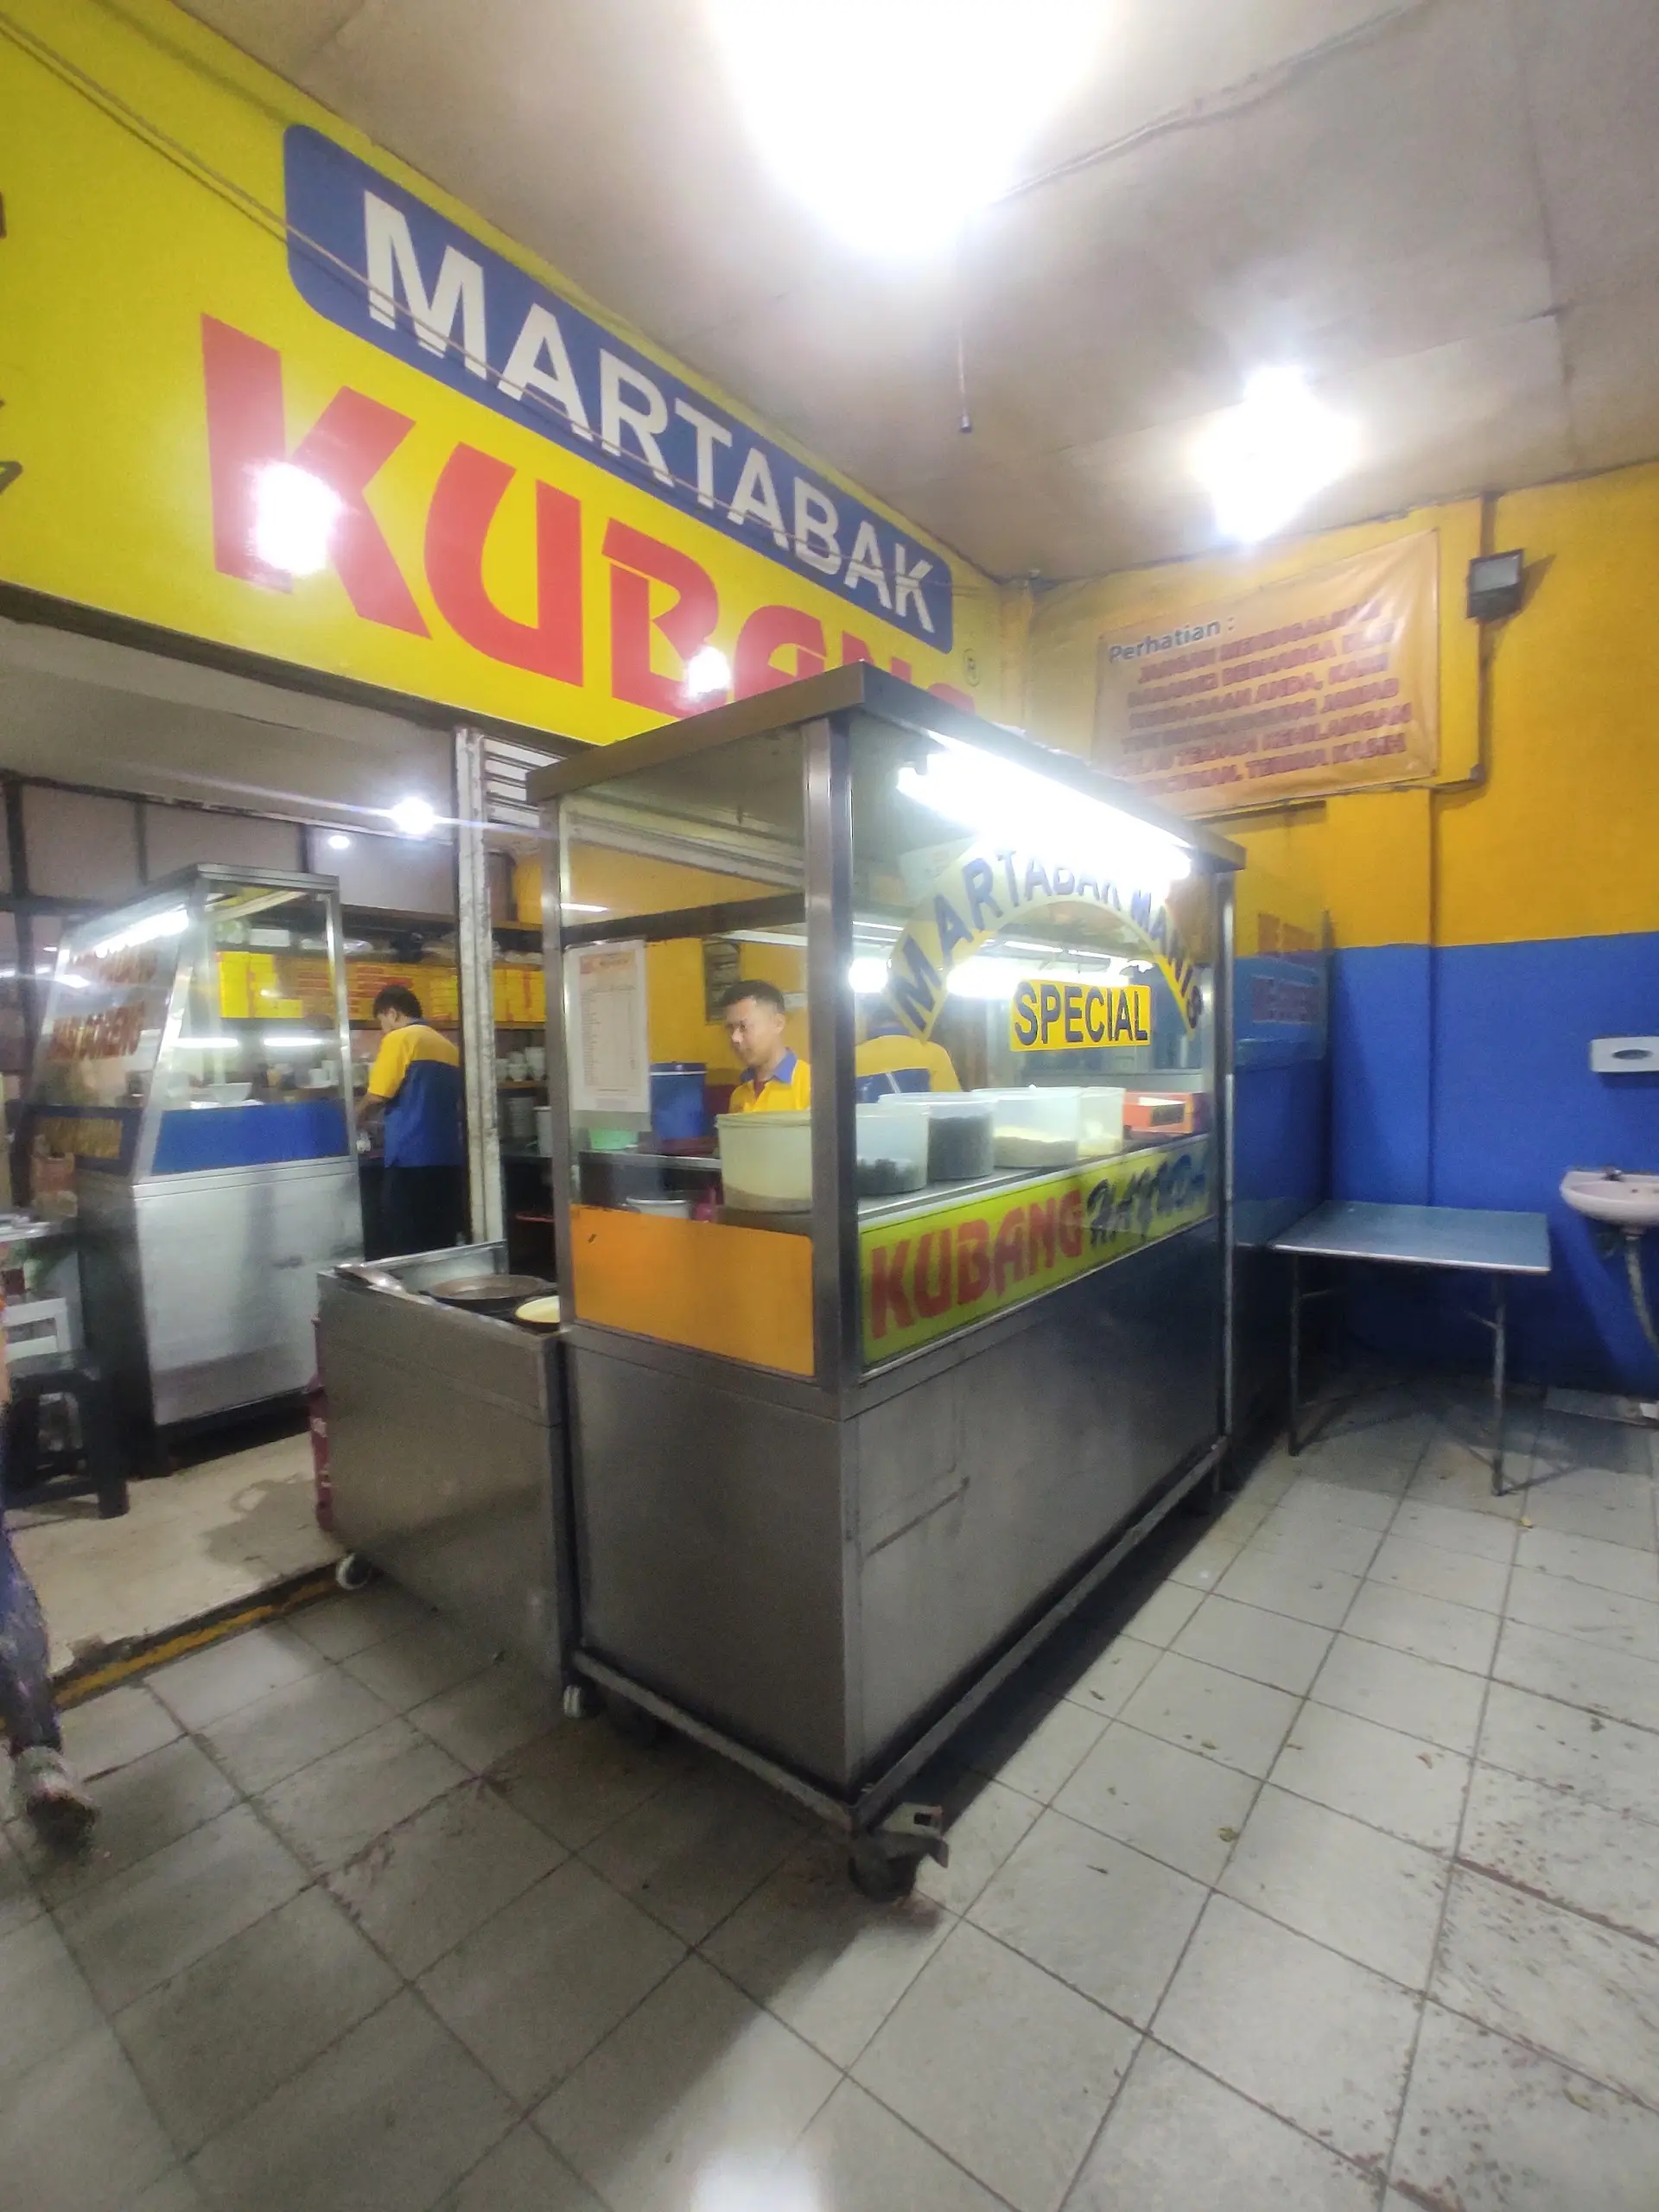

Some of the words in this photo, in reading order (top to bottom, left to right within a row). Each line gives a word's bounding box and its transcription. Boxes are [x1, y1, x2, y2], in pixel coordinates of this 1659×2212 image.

[364, 192, 934, 632] MARTABAK
[1109, 619, 1221, 664] Perhatian
[1014, 981, 1148, 1046] SPECIAL
[870, 1188, 1084, 1339] KUBANG
